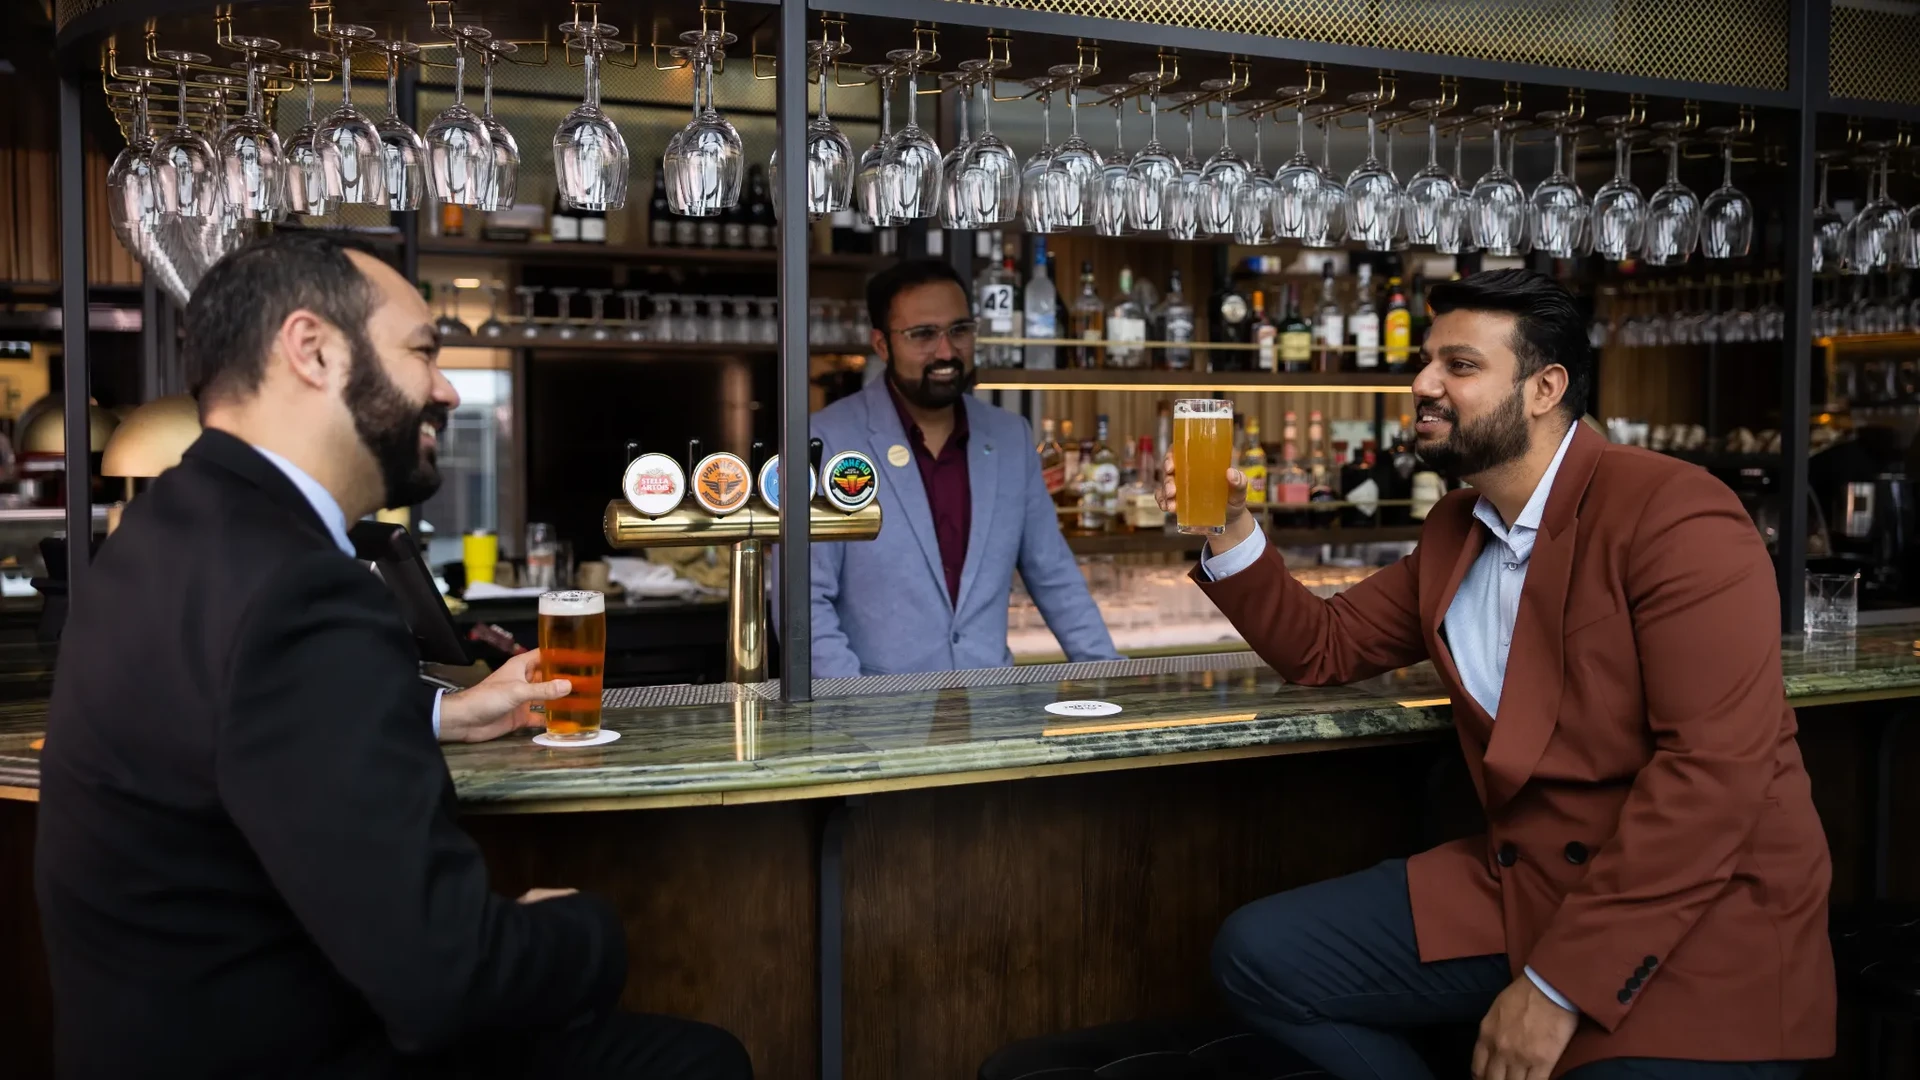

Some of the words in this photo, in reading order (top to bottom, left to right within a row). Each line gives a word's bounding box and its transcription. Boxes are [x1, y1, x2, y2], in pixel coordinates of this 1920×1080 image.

[985, 289, 1008, 310] 42
[703, 461, 743, 479] PANHEAD
[834, 458, 871, 476] PANHEAD
